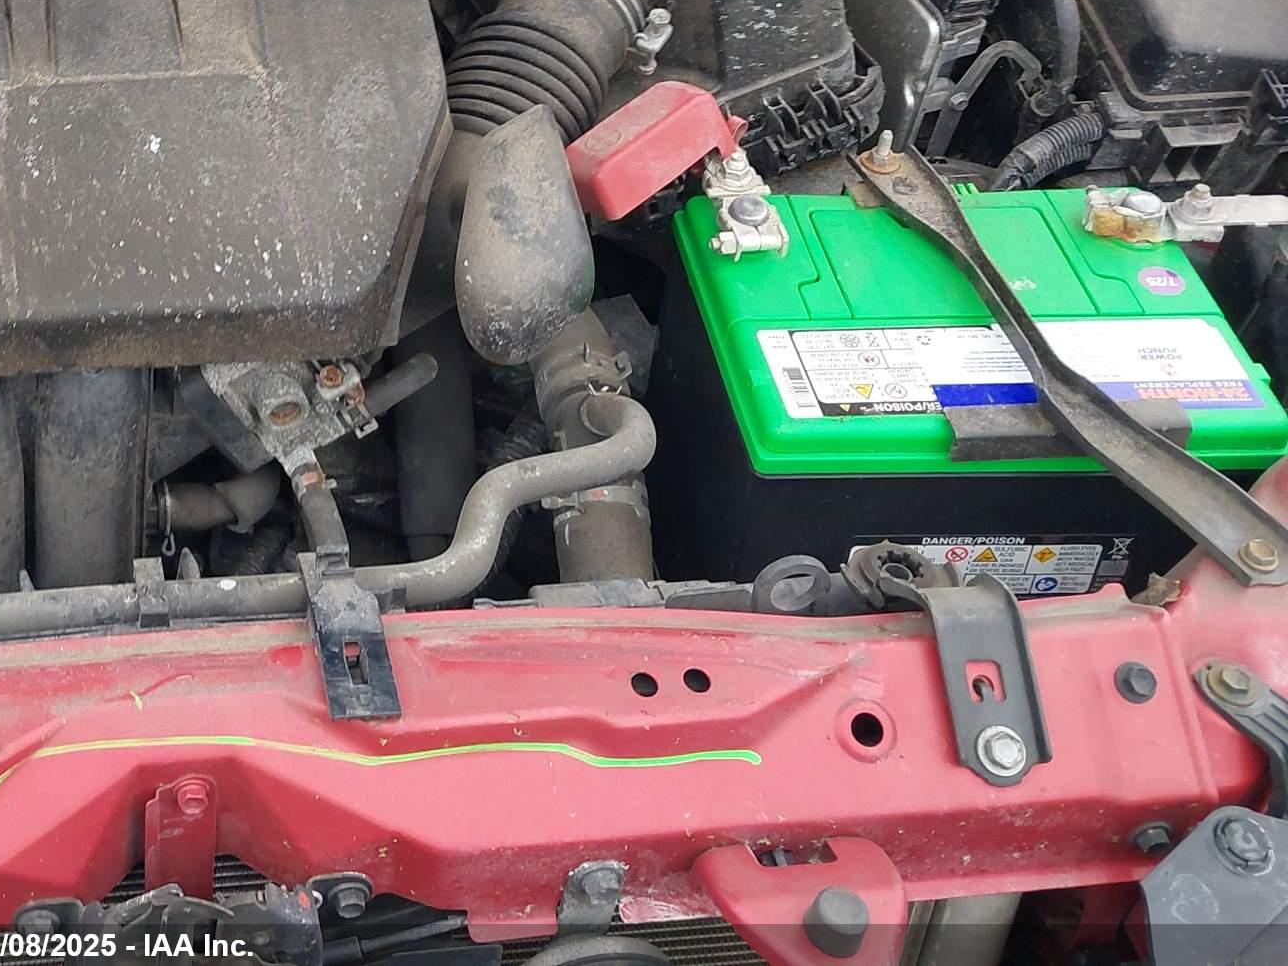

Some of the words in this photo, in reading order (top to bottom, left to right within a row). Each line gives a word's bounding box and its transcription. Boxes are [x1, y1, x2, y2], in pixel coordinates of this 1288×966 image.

[1133, 381, 1215, 389] REPLACEMENT
[1220, 381, 1244, 389] FREE
[922, 537, 1026, 545] DANGER/POISON
